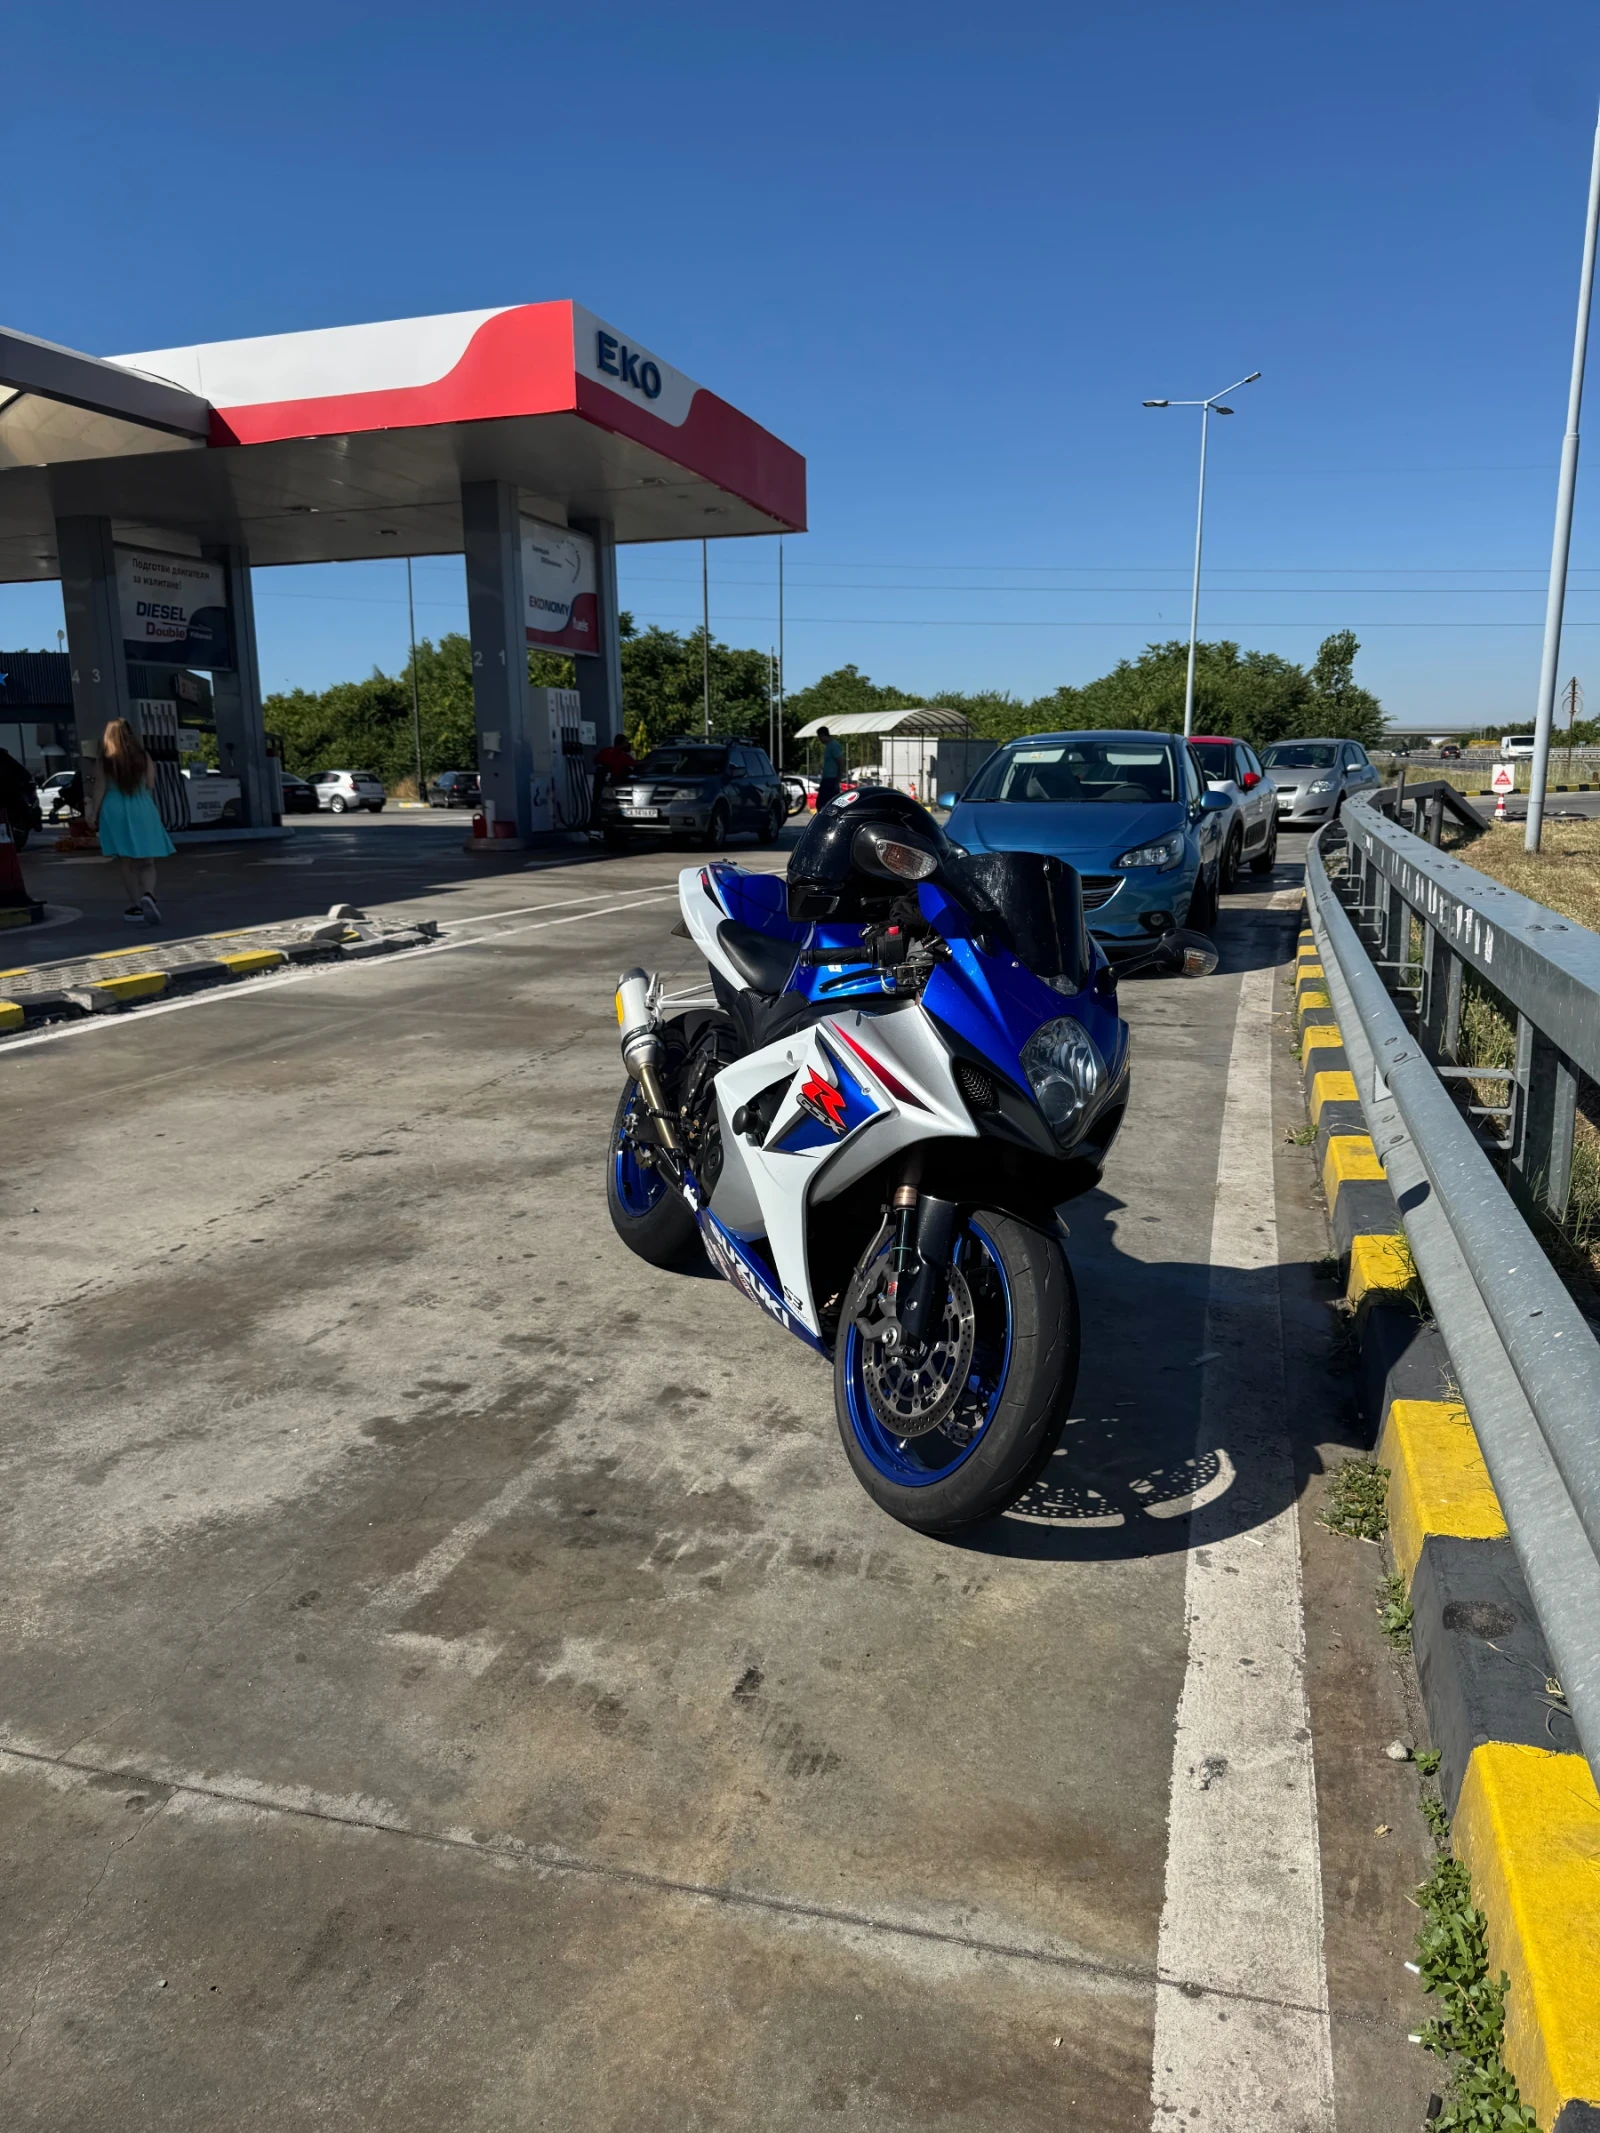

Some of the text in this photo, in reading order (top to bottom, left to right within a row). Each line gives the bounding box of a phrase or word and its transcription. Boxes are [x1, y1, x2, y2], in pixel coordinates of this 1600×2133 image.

[597, 330, 662, 399] EKO
[132, 558, 210, 580] Подготви двигателя
[133, 576, 182, 590] за излитане!
[136, 601, 187, 622] DIESEL
[529, 595, 570, 616] EKONOMY
[146, 622, 186, 639] Double
[572, 616, 589, 632] fuels
[473, 649, 506, 667] 2 1
[72, 668, 101, 684] 4 3
[796, 1093, 847, 1136] GSX
[709, 1218, 790, 1330] SUZUKI
